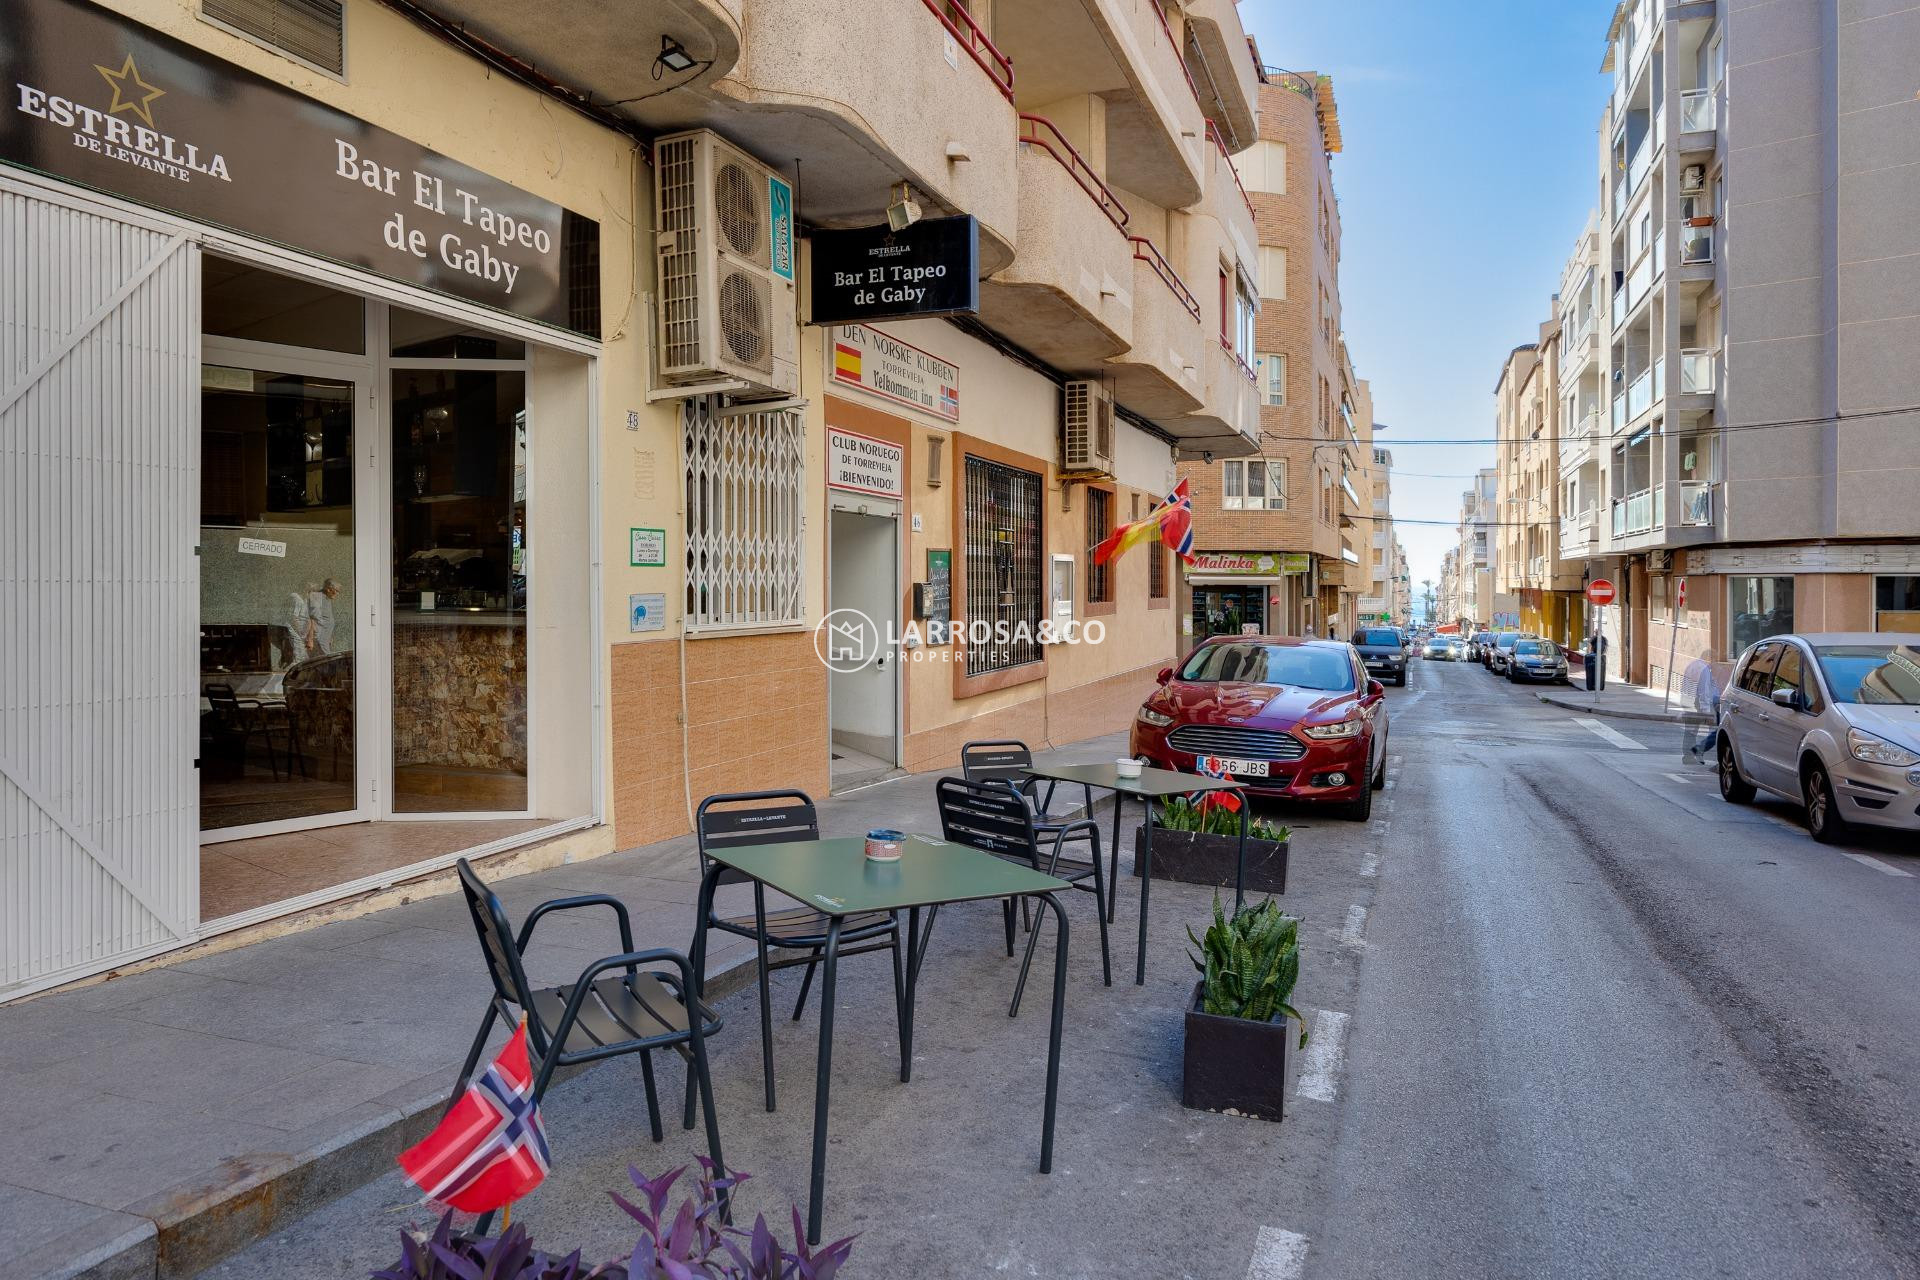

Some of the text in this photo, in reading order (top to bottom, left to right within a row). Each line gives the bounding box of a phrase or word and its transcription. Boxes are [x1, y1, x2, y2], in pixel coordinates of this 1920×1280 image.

[17, 83, 232, 182] ESTRELLA
[73, 133, 190, 183] DE LEVANTE
[335, 138, 551, 254] Bar El Tapeo
[383, 212, 520, 294] de Gaby
[780, 215, 789, 271] SALAZAR
[868, 245, 911, 256] ESTRELLA
[834, 265, 946, 287] Bar El Tapeo
[854, 286, 926, 305] de Gaby
[843, 324, 953, 383] DEN NORSKE KLUBBEN
[882, 360, 924, 385] TORREVIEJA
[873, 370, 933, 407] Velkommen inn
[832, 435, 900, 461] CLUB NORUEGO
[842, 454, 892, 473] DE TORREVIEJA
[840, 470, 894, 490] ¡BIENVENIDO!
[242, 541, 283, 553] CERRADO
[1193, 555, 1255, 569] Malinka
[1243, 762, 1266, 775] JBS
